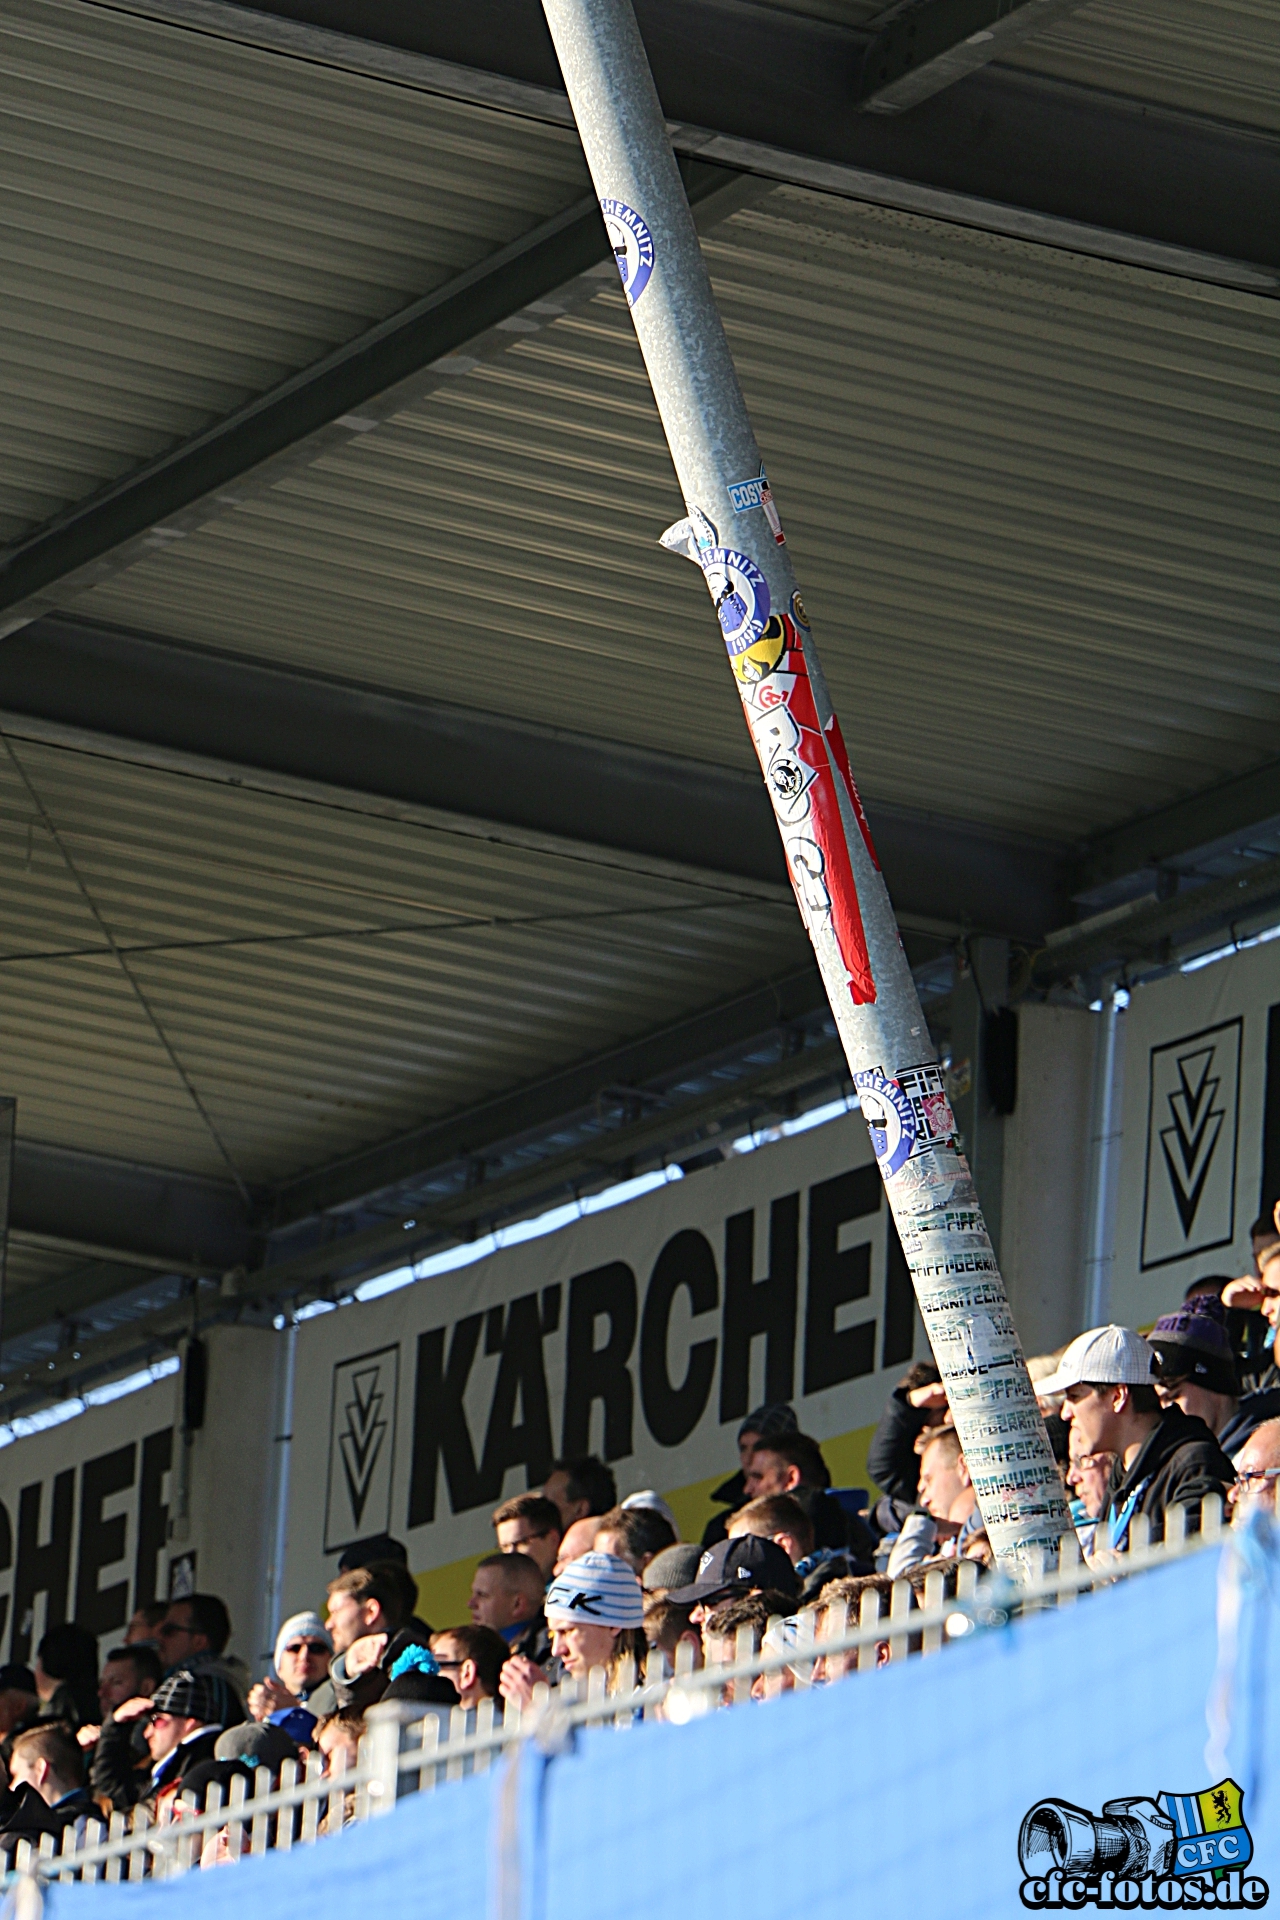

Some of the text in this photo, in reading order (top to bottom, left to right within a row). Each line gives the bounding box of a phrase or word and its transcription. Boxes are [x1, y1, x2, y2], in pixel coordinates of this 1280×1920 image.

[600, 199, 653, 268] CHEMNITZ
[699, 549, 765, 588] HEMNITZ
[856, 1072, 916, 1140] CHEMNITZ
[406, 1163, 919, 1530] KÄRCHE
